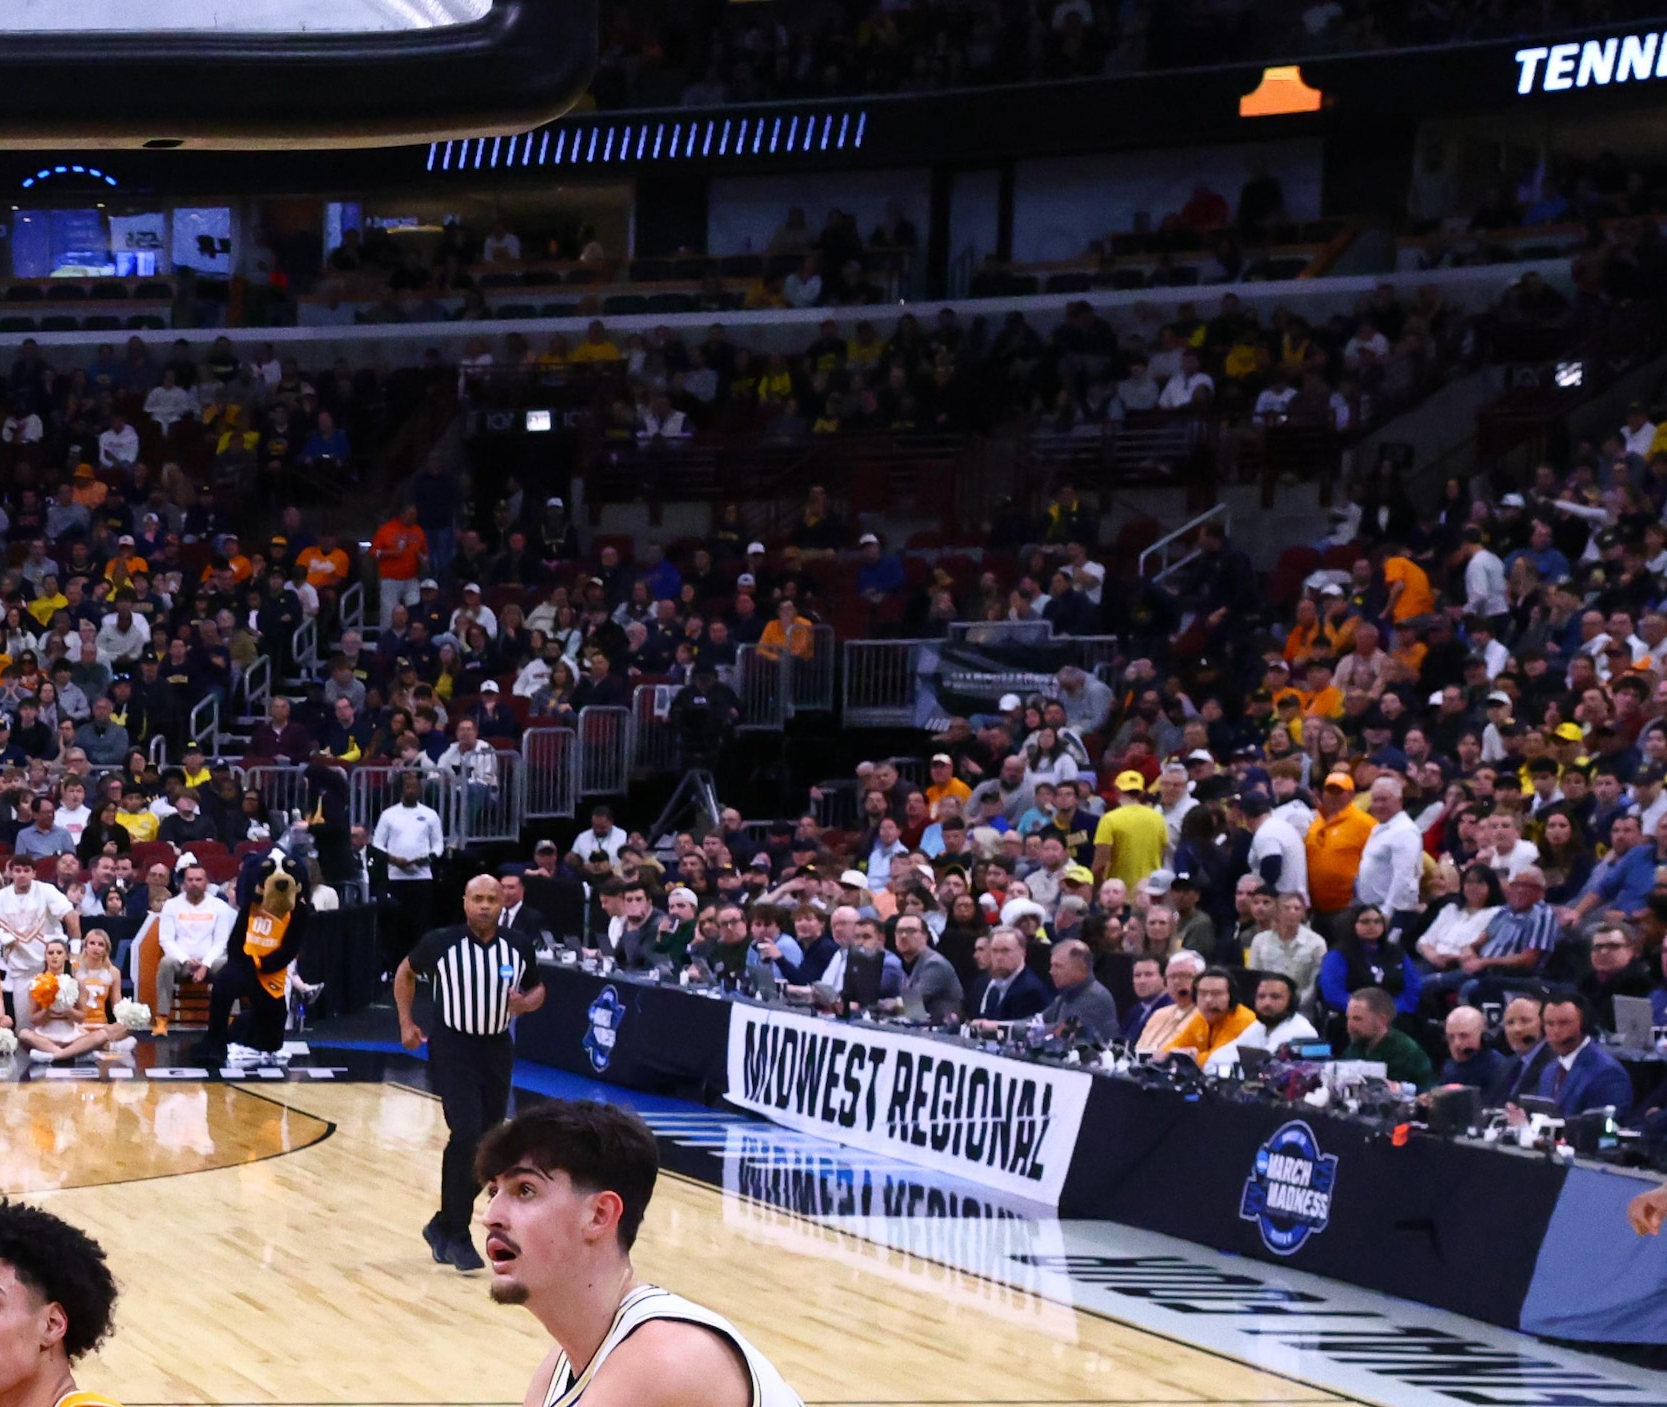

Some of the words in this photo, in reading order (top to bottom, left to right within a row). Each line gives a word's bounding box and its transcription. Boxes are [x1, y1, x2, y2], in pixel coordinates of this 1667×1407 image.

[742, 1020, 887, 1133] MIDWEST
[886, 1049, 1053, 1182] REGIONAL
[1266, 1152, 1313, 1188] MARCH
[1266, 1181, 1329, 1220] MADNESS
